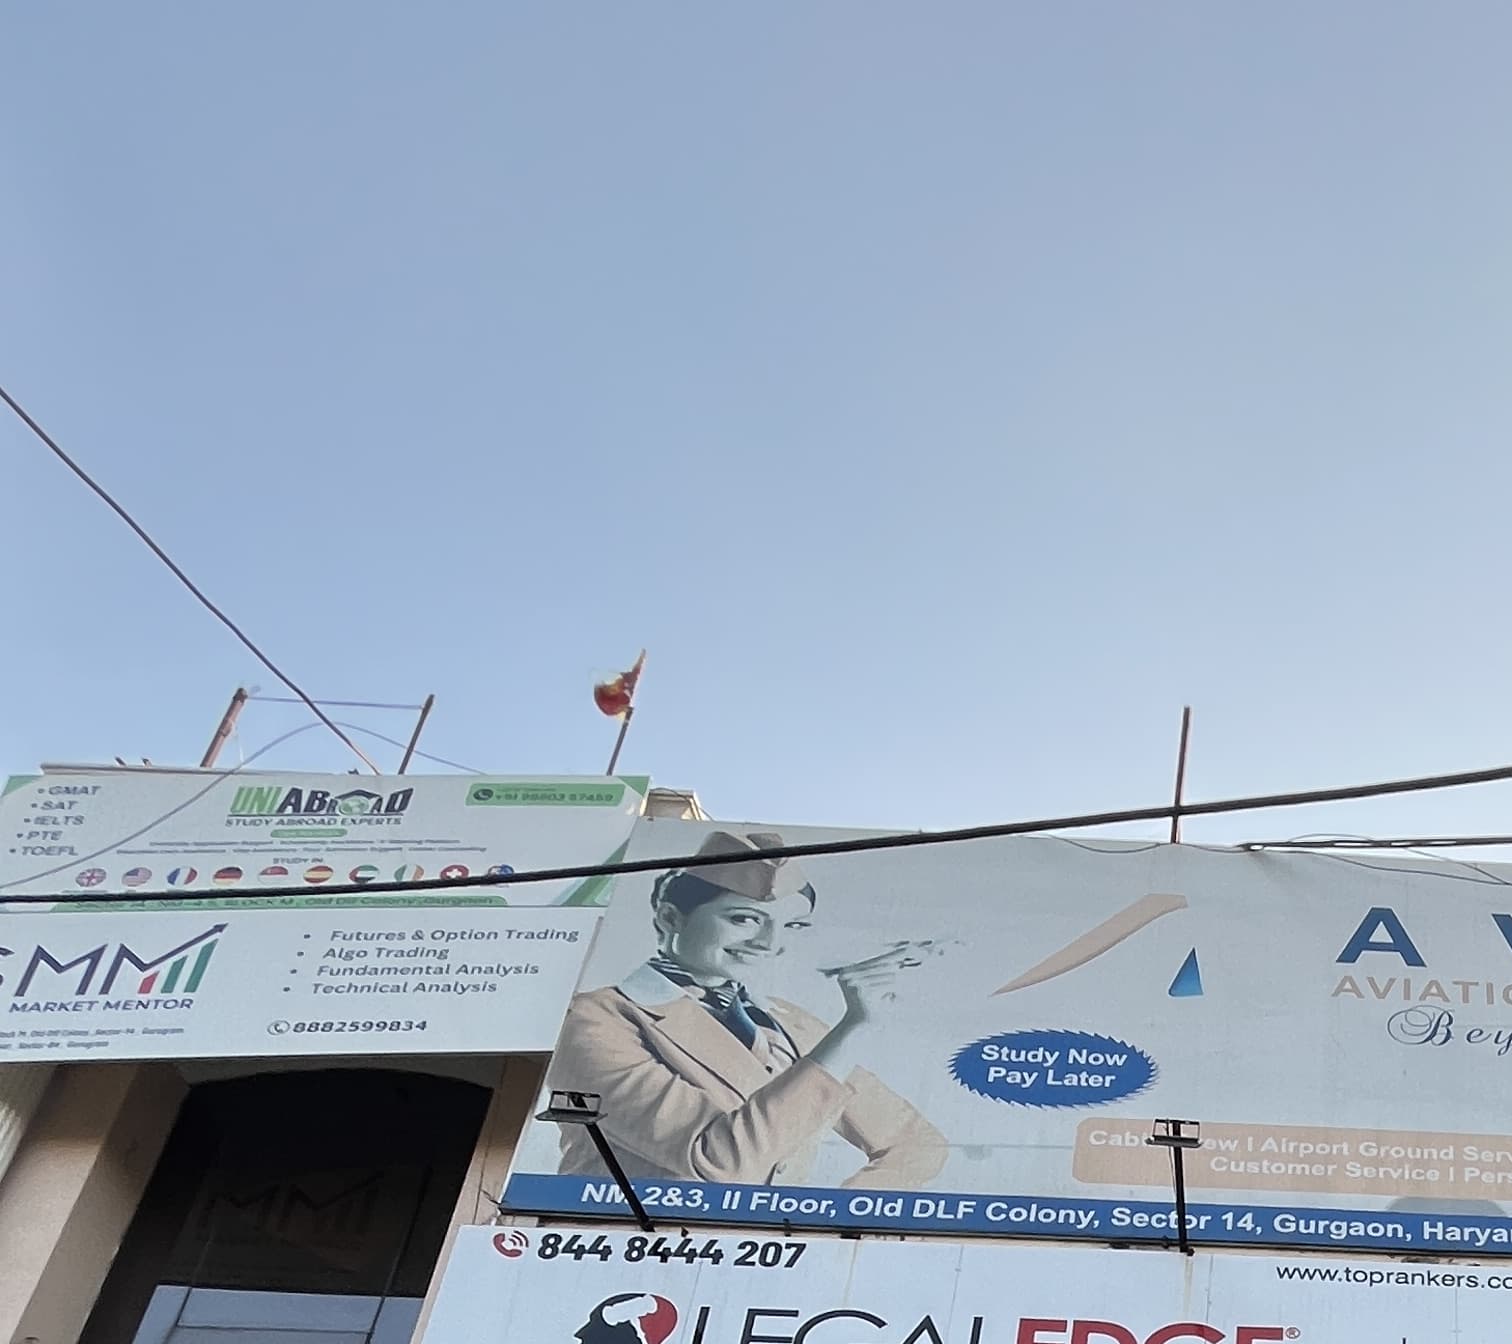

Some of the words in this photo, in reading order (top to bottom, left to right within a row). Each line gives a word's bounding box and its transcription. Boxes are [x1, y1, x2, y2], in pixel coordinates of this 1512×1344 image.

[330, 930, 406, 942] Futures
[430, 929, 498, 942] Option
[504, 929, 579, 943] Trading
[323, 947, 368, 961] Algo
[375, 947, 449, 961] Trading
[316, 964, 451, 977] Fundamental
[455, 963, 540, 978] Analysis
[312, 982, 409, 995] Technical
[413, 981, 498, 995] Analysis
[8, 1000, 98, 1013] MARKET
[103, 998, 194, 1011] MENTOR
[981, 1043, 1060, 1068] Study
[1066, 1047, 1128, 1069] Now
[986, 1066, 1039, 1088] Pay
[1045, 1069, 1116, 1089] Later
[1264, 1136, 1351, 1157] Airport
[1359, 1142, 1455, 1161] Ground
[747, 1191, 838, 1220] Floor,
[848, 1195, 902, 1217] Old
[912, 1199, 977, 1221] DLF
[985, 1201, 1101, 1230] Colony,
[1111, 1207, 1212, 1231] Sector
[1221, 1211, 1263, 1236] 14,
[1273, 1213, 1413, 1242] Gurgaon,
[536, 1233, 613, 1262] 844
[623, 1236, 725, 1266] 8444
[735, 1240, 807, 1269] 207
